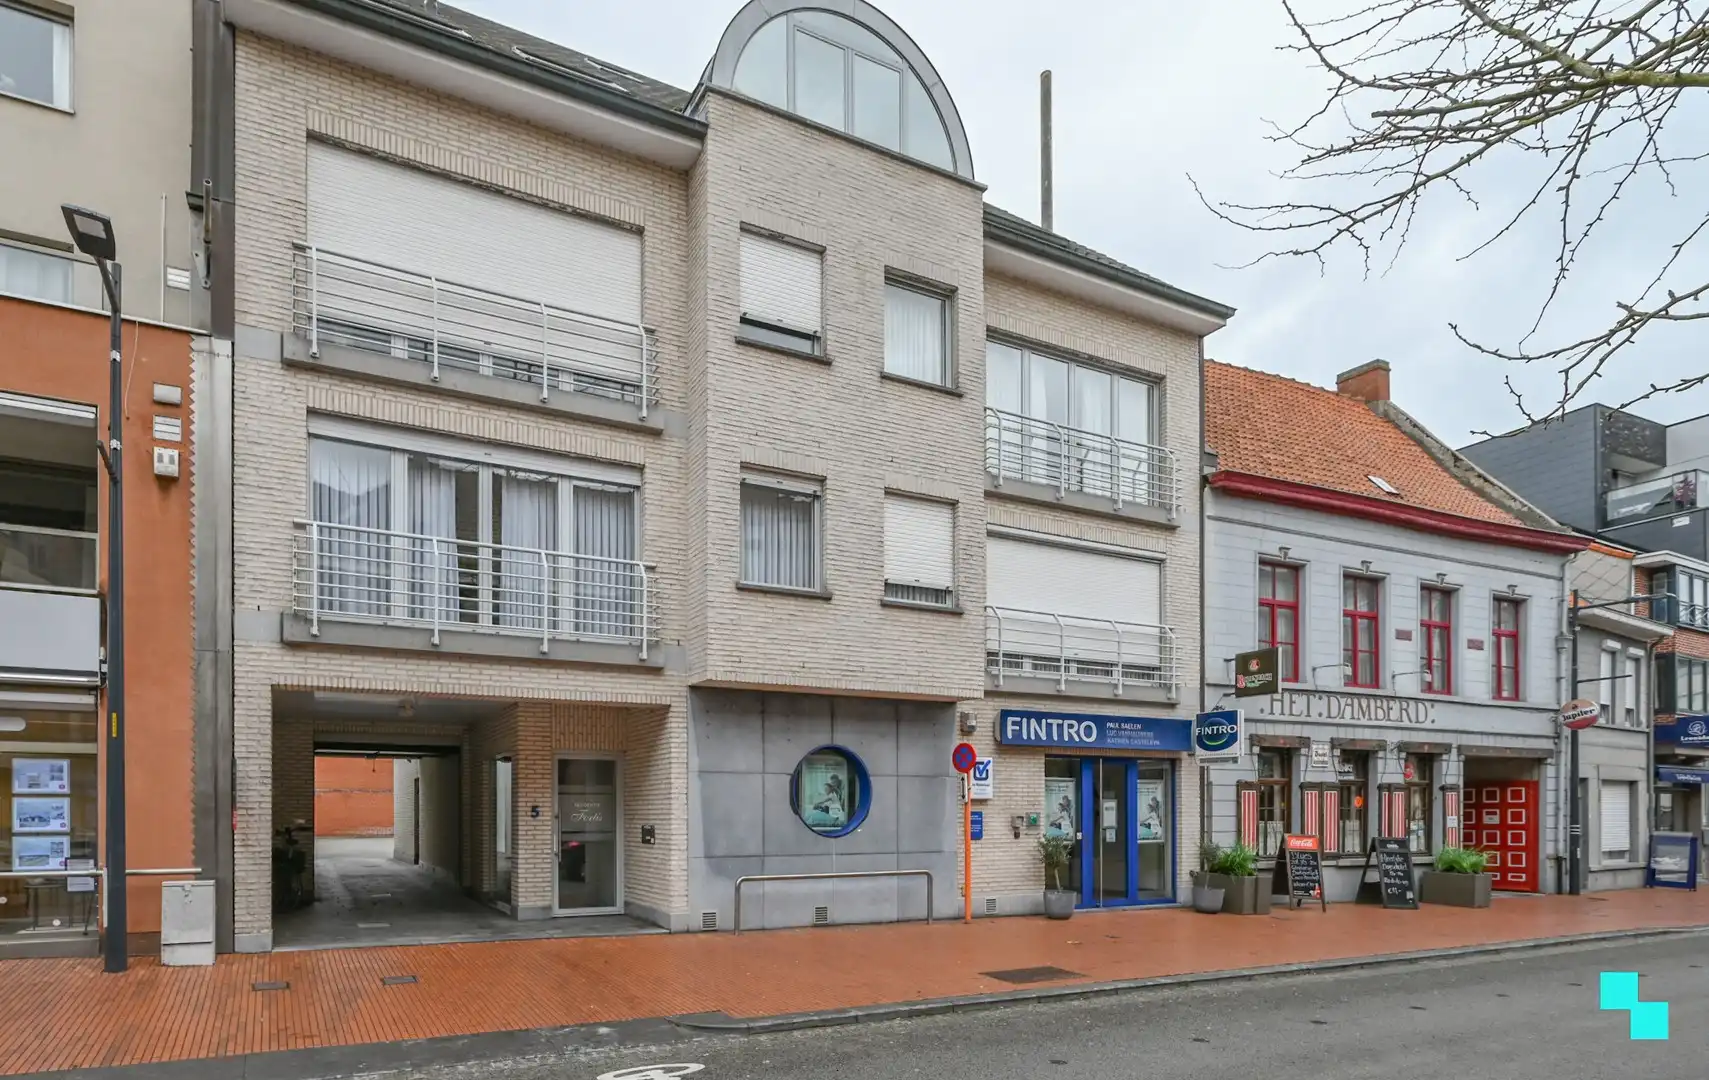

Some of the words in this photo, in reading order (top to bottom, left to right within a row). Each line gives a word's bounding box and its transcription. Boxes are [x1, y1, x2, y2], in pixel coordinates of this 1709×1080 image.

[1006, 716, 1098, 743] FINTRO
[1195, 724, 1237, 736] FINTRO
[530, 805, 541, 818] 5
